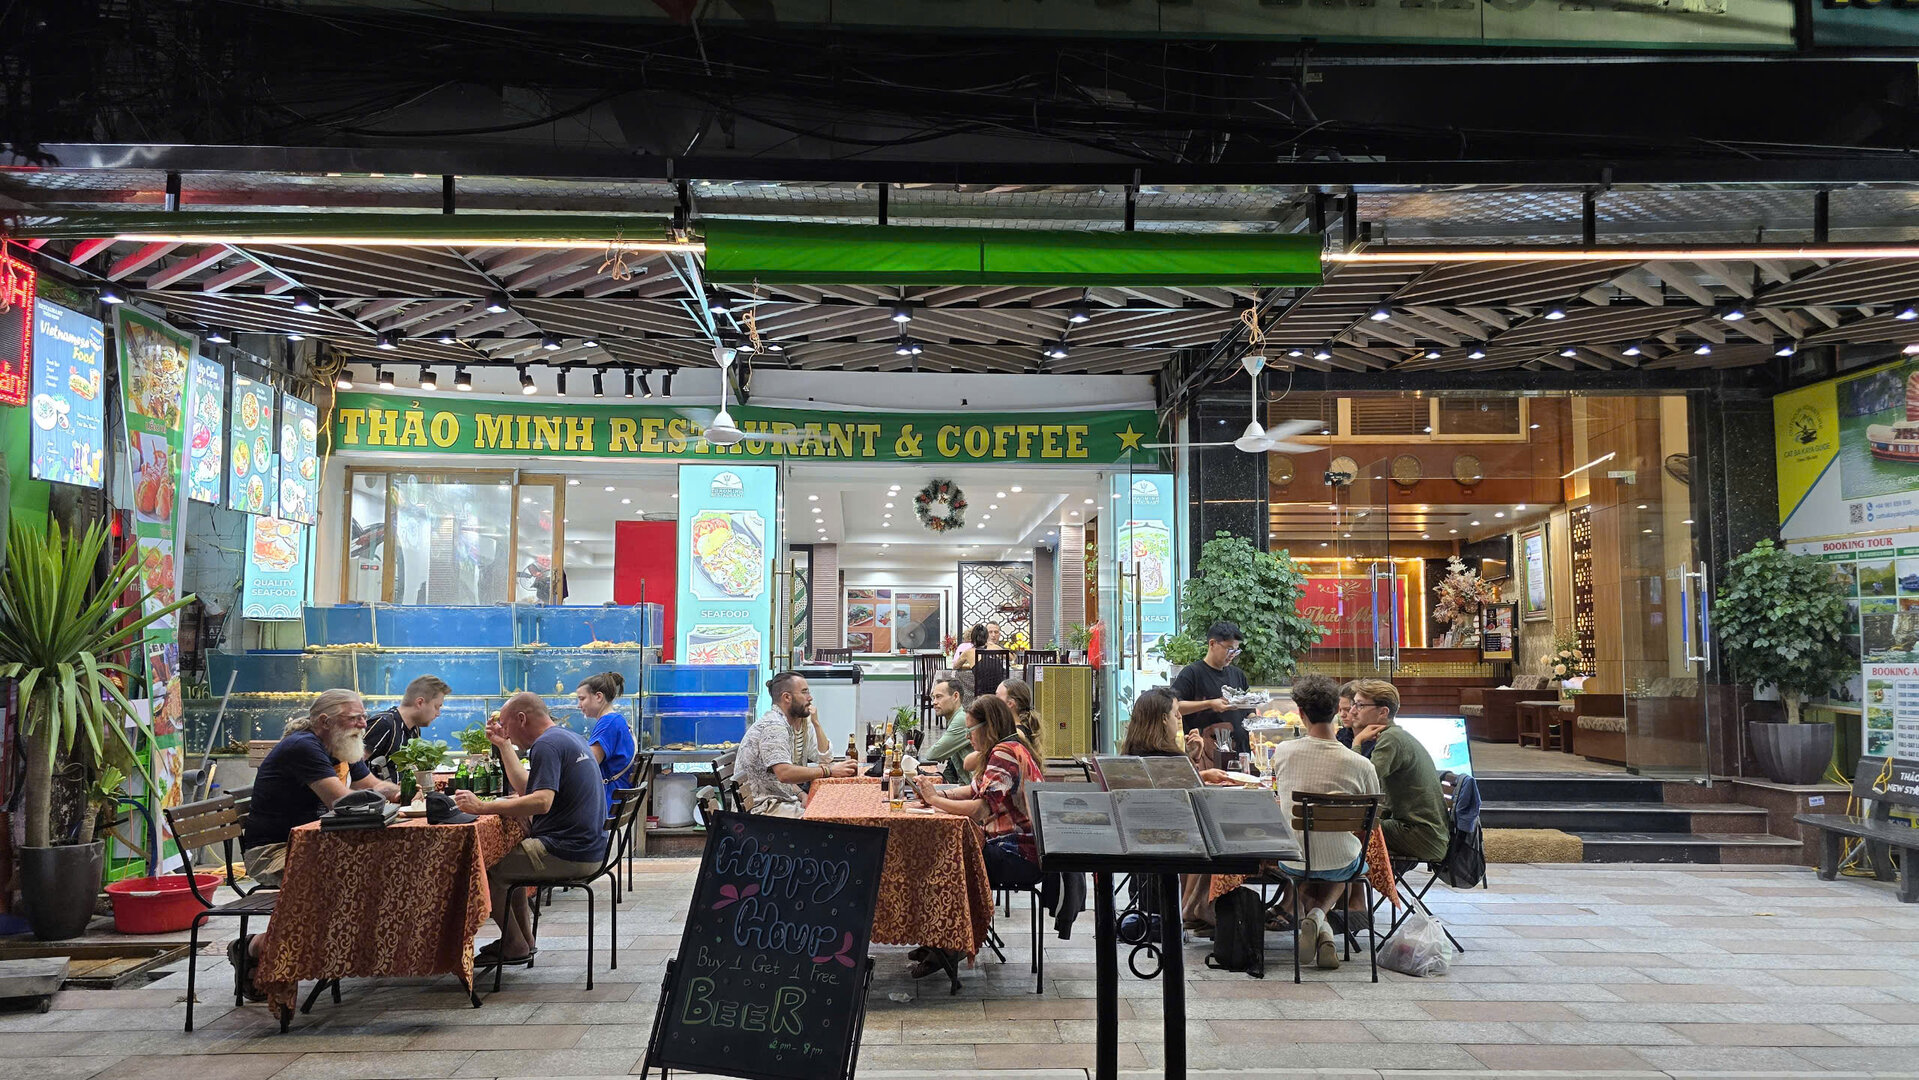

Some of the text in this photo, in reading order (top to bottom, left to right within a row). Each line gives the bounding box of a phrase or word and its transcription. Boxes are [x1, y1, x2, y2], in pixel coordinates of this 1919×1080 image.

[40, 319, 91, 349] Vietnamese
[72, 346, 96, 365] Food
[339, 400, 1090, 459] THẢO MINH RESTURANT & COFFEE
[1823, 537, 1894, 552] BOOKING TOUR
[253, 579, 295, 587] QUALITY
[251, 588, 297, 597] SEAFOOD
[701, 609, 750, 619] SEAFOOD
[1872, 667, 1910, 676] BOOKING
[1887, 783, 1904, 793] NEW
[715, 836, 849, 903] Happy
[734, 897, 838, 957] Hour
[697, 946, 841, 985] Buy 1 Get 1 Free
